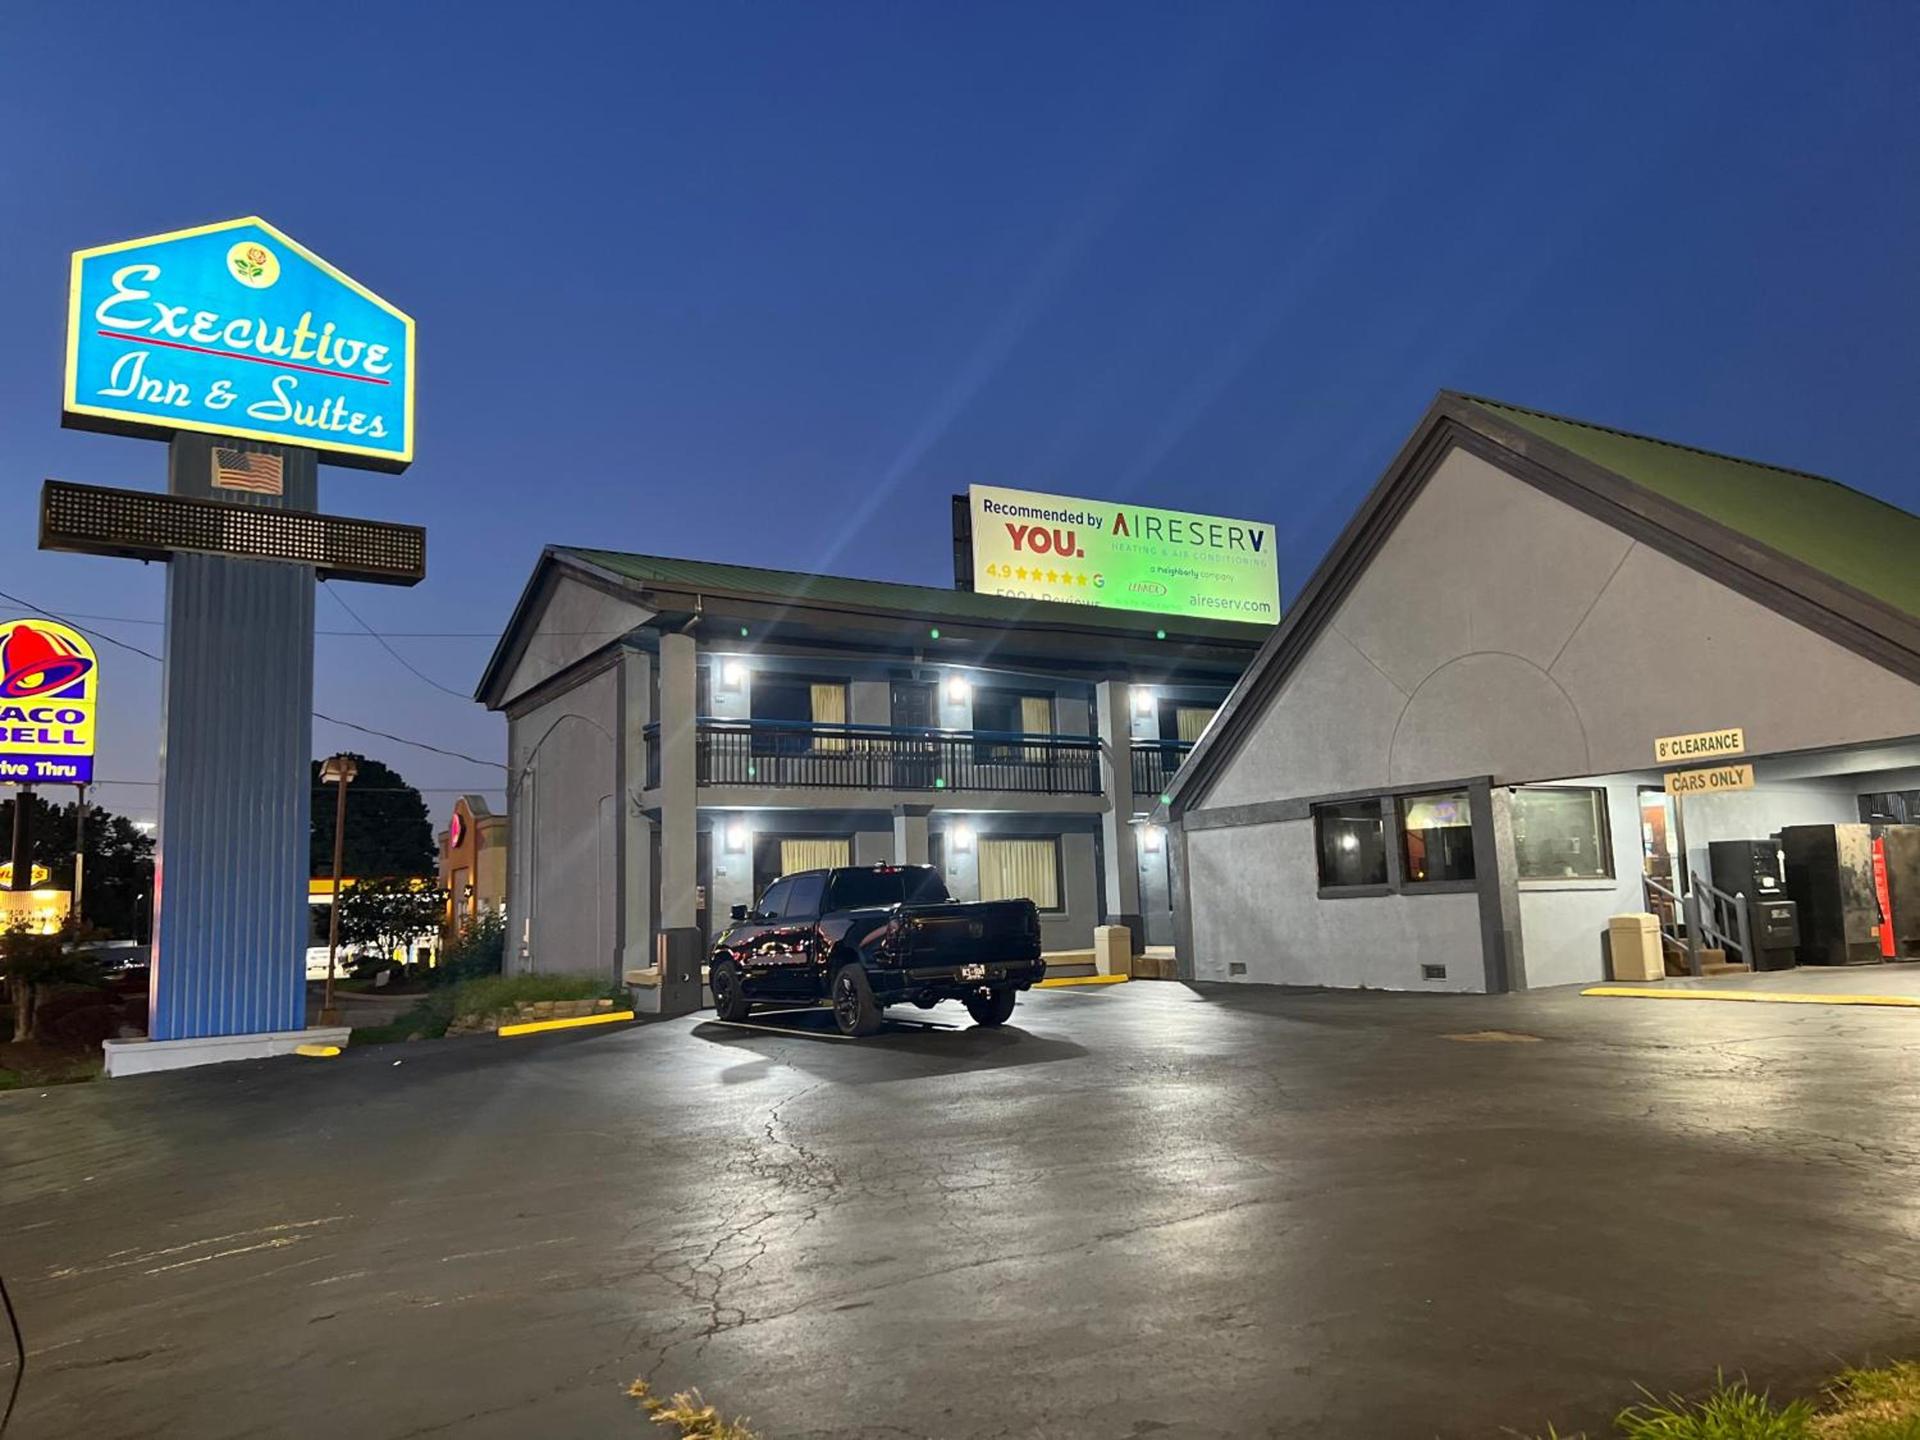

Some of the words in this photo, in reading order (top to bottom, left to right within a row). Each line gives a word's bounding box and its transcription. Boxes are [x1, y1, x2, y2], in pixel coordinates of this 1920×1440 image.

[95, 264, 393, 374] Executive
[97, 351, 191, 407] Inn
[204, 381, 238, 409] &
[247, 375, 389, 438] Suites
[983, 499, 1083, 524] Recommended
[1087, 512, 1102, 529] by
[1005, 523, 1084, 558] YOU.
[1112, 512, 1264, 552] AIRESERV
[1112, 543, 1157, 556] HEATING
[1174, 550, 1189, 558] AIR
[1194, 551, 1267, 567] CONDITIONING
[986, 564, 1011, 578] 4.9
[1157, 566, 1198, 579] neighborly
[1190, 594, 1270, 613] aireserv.com
[0, 706, 85, 724] ACO
[1660, 742, 1668, 757] 8'
[1672, 734, 1739, 755] CLEARANCE
[35, 761, 77, 777] Thru
[1672, 774, 1706, 791] CARS
[1710, 769, 1744, 787] ONLY
